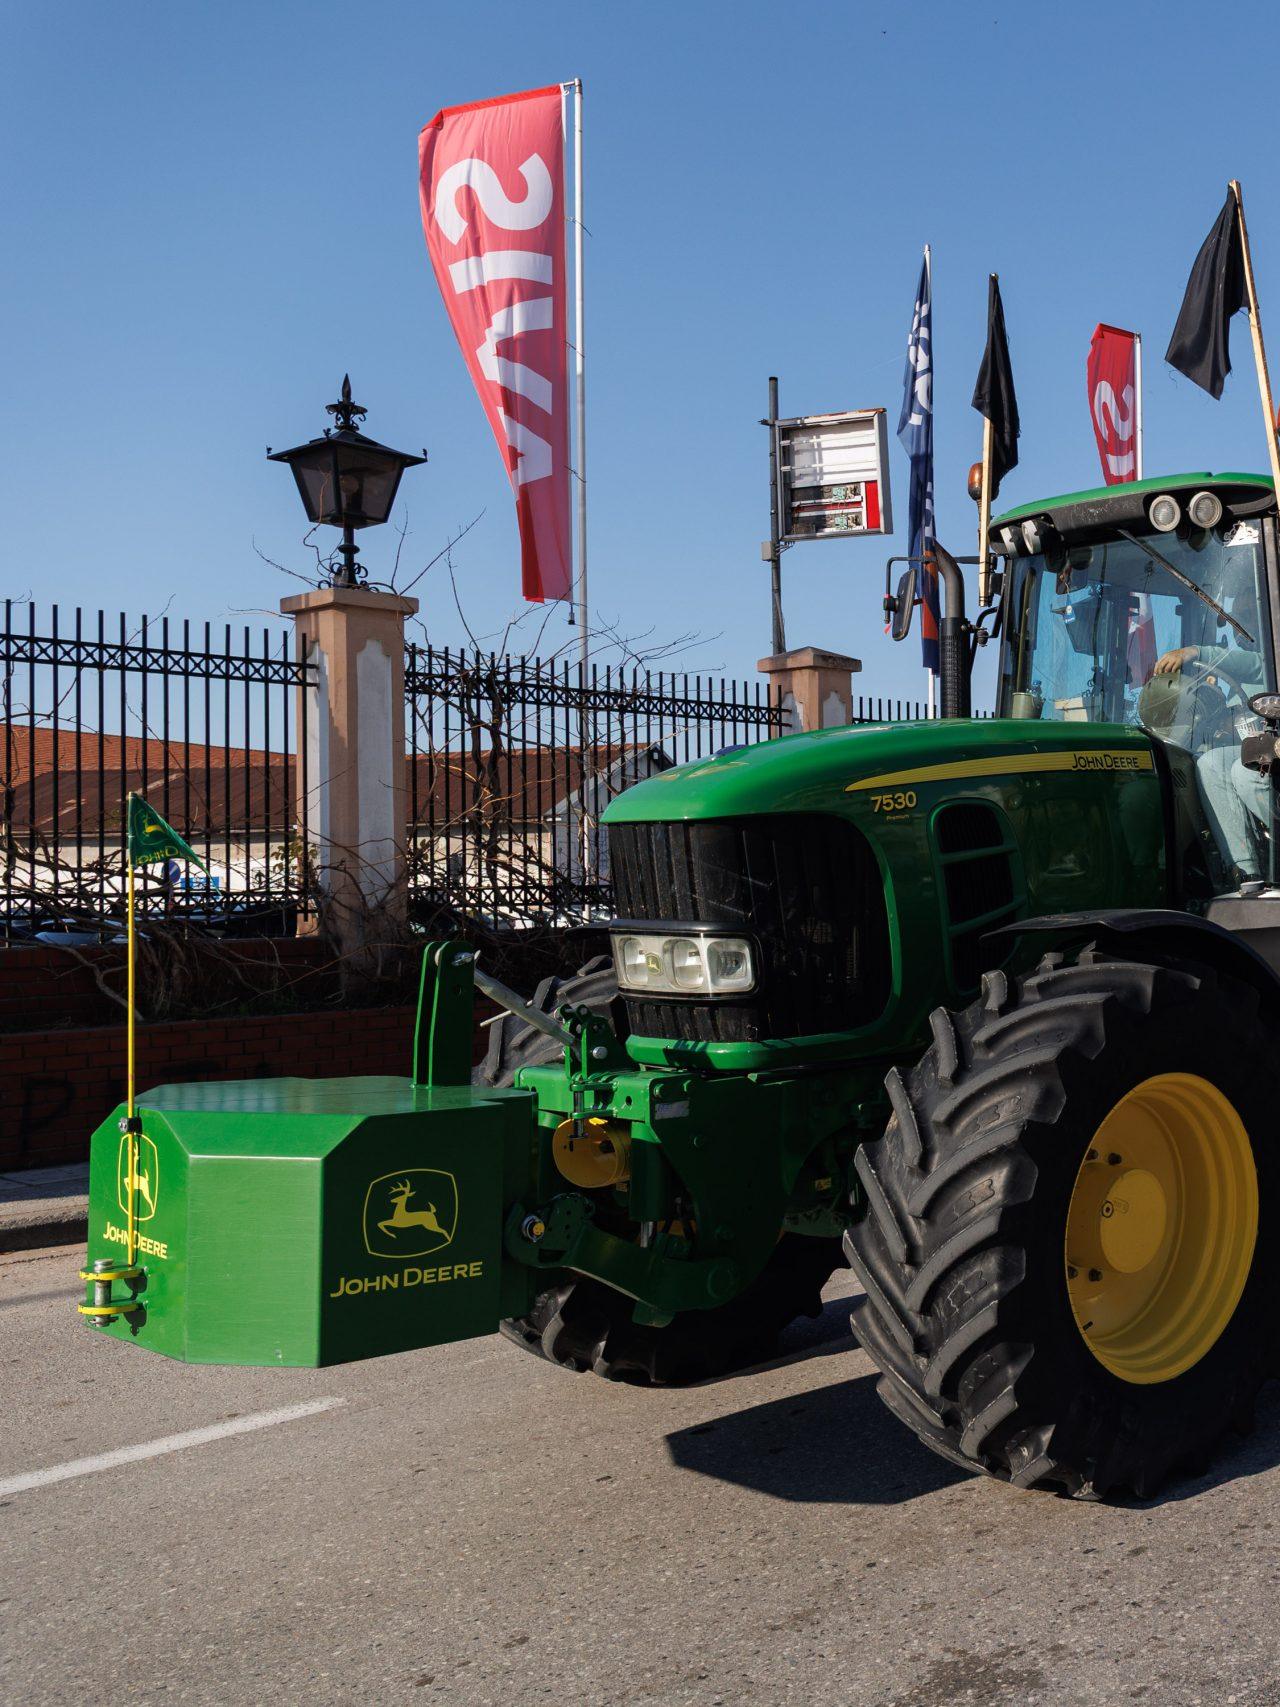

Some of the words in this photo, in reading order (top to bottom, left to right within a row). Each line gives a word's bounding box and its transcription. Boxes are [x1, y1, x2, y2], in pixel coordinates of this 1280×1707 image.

[1072, 753, 1104, 768] JOHN
[1104, 754, 1140, 768] DEERE
[871, 791, 917, 813] 7530
[103, 1221, 130, 1247] JOHN
[330, 1273, 399, 1298] JOHN
[403, 1261, 483, 1287] DEERE
